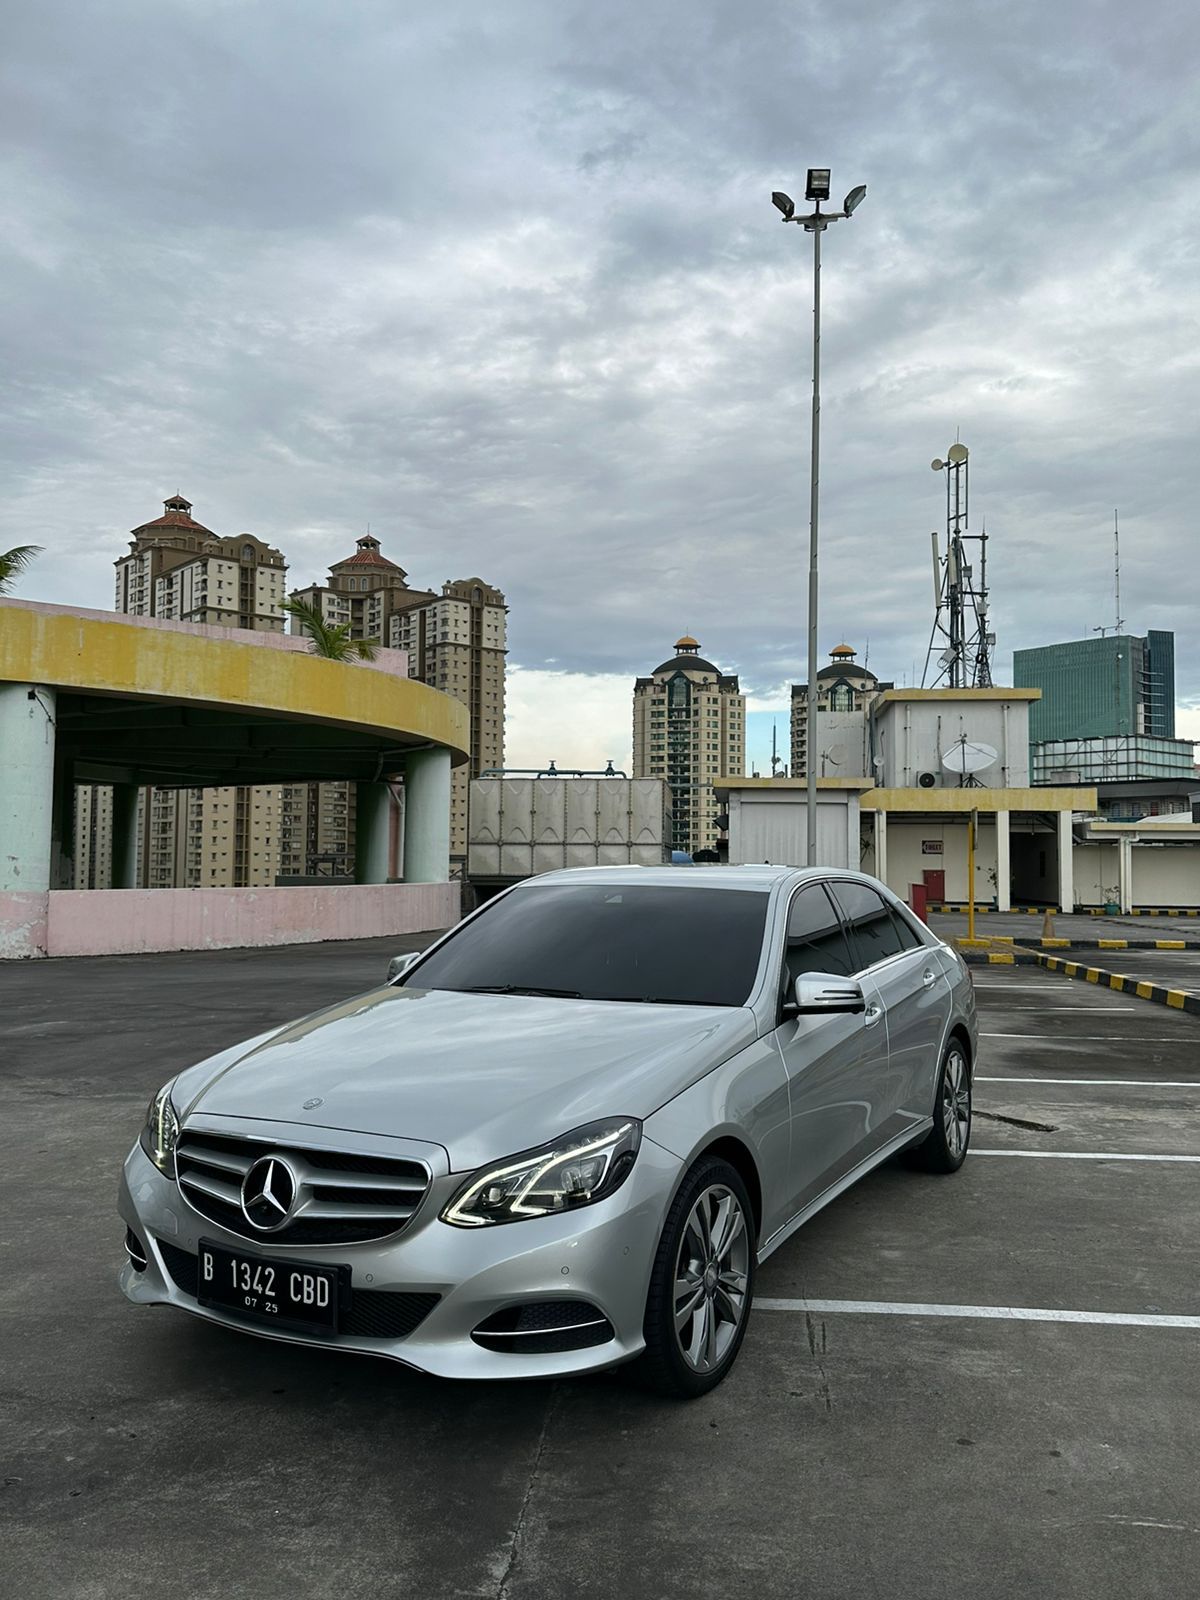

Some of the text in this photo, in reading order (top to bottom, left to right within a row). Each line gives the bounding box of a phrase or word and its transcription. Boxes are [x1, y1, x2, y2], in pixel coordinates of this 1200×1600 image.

[204, 1252, 329, 1307] B 1342 CBD
[245, 1297, 278, 1313] 07 25
